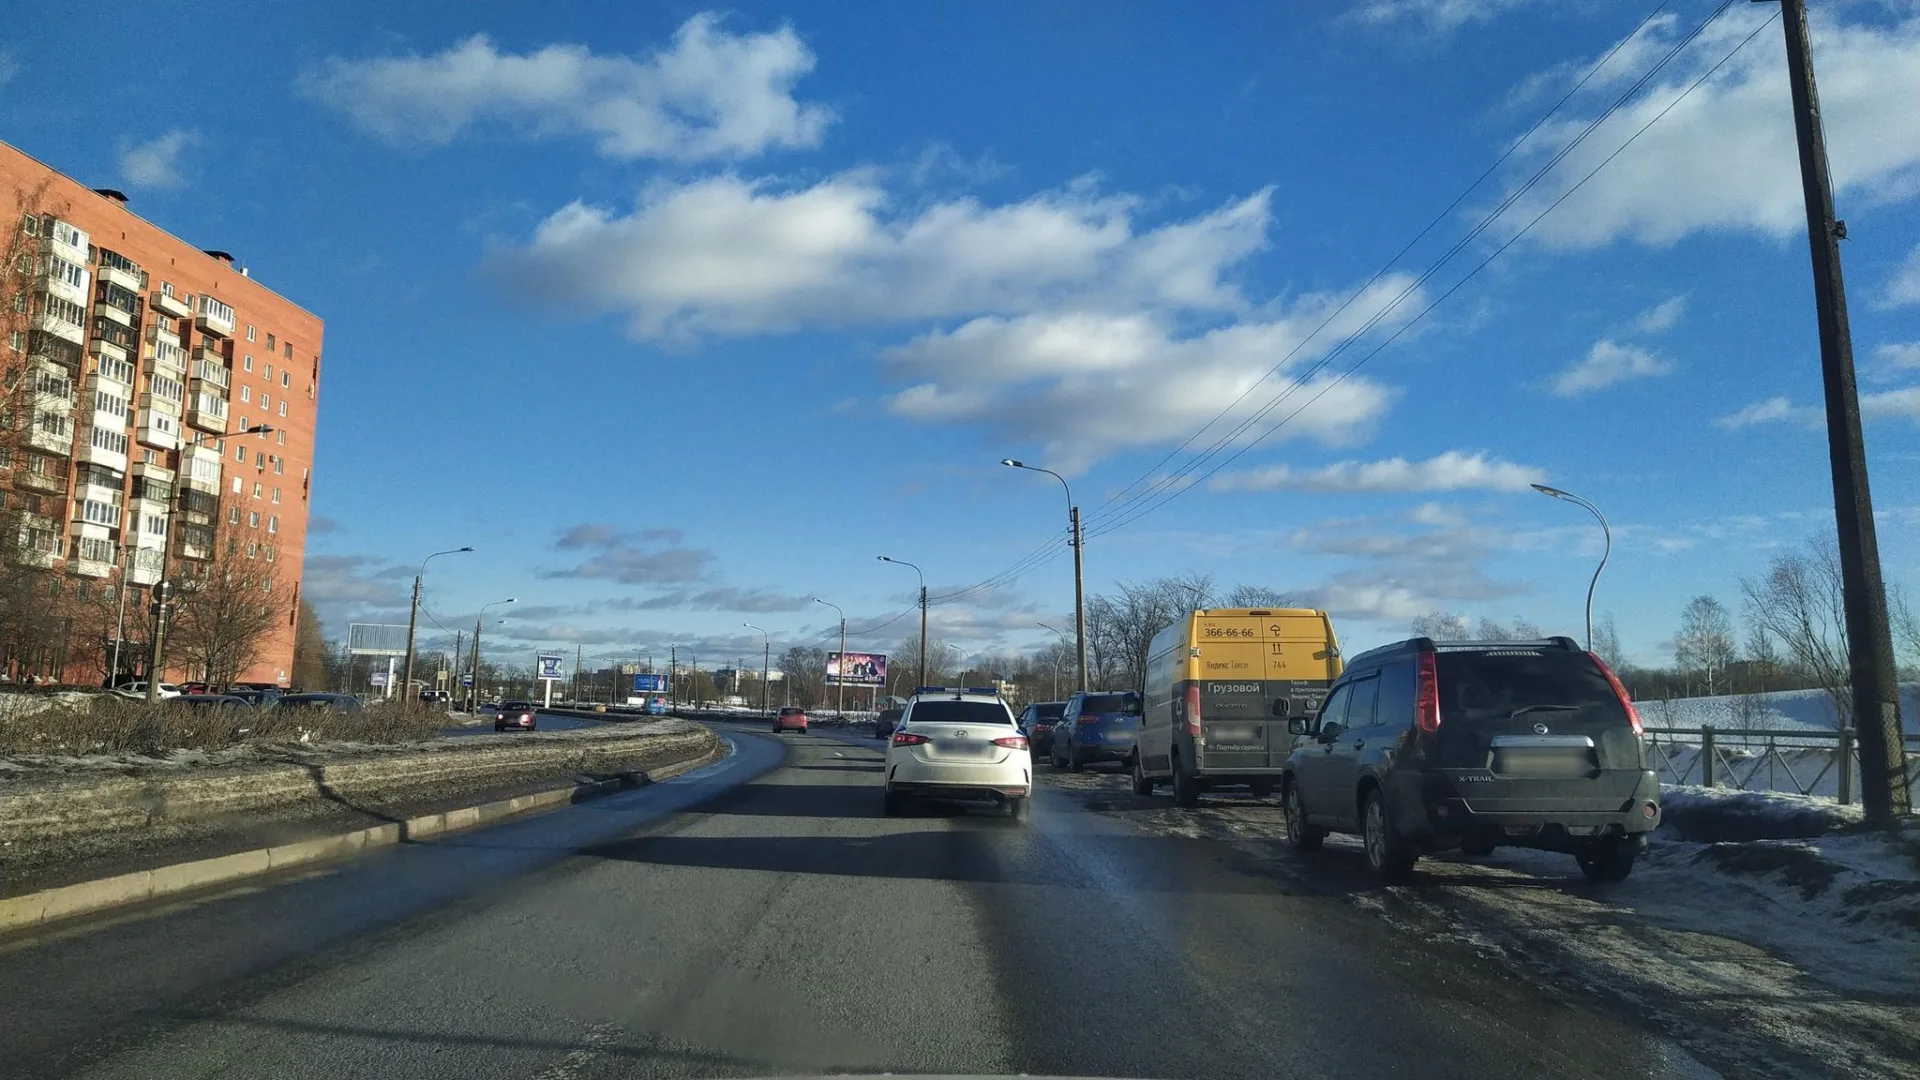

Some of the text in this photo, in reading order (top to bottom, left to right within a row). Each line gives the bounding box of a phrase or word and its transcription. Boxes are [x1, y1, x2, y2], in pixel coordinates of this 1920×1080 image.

[1204, 628, 1254, 637] 366-66-66
[1206, 660, 1249, 670] Яндекс Такси
[1273, 660, 1286, 669] 744
[1207, 682, 1260, 694] Грузовой
